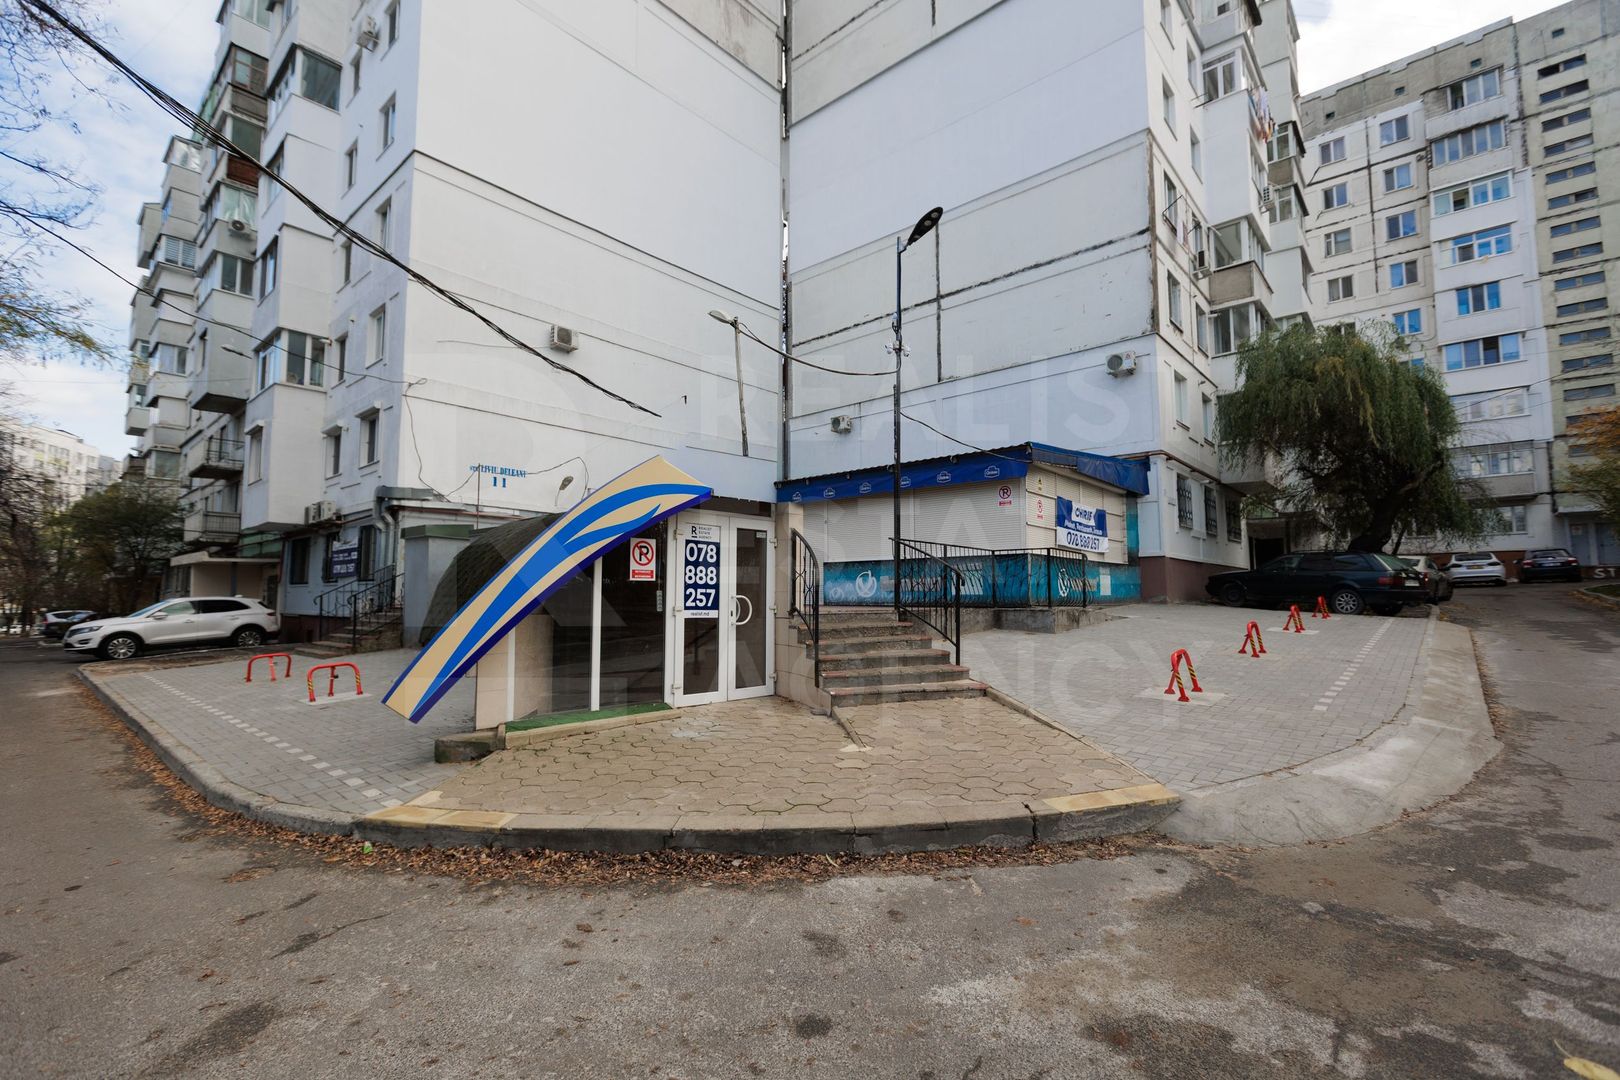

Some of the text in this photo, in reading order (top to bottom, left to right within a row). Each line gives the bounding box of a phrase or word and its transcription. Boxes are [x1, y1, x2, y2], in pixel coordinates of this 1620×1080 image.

[685, 543, 717, 563] 078
[685, 565, 717, 585] 888
[685, 588, 716, 607] 257
